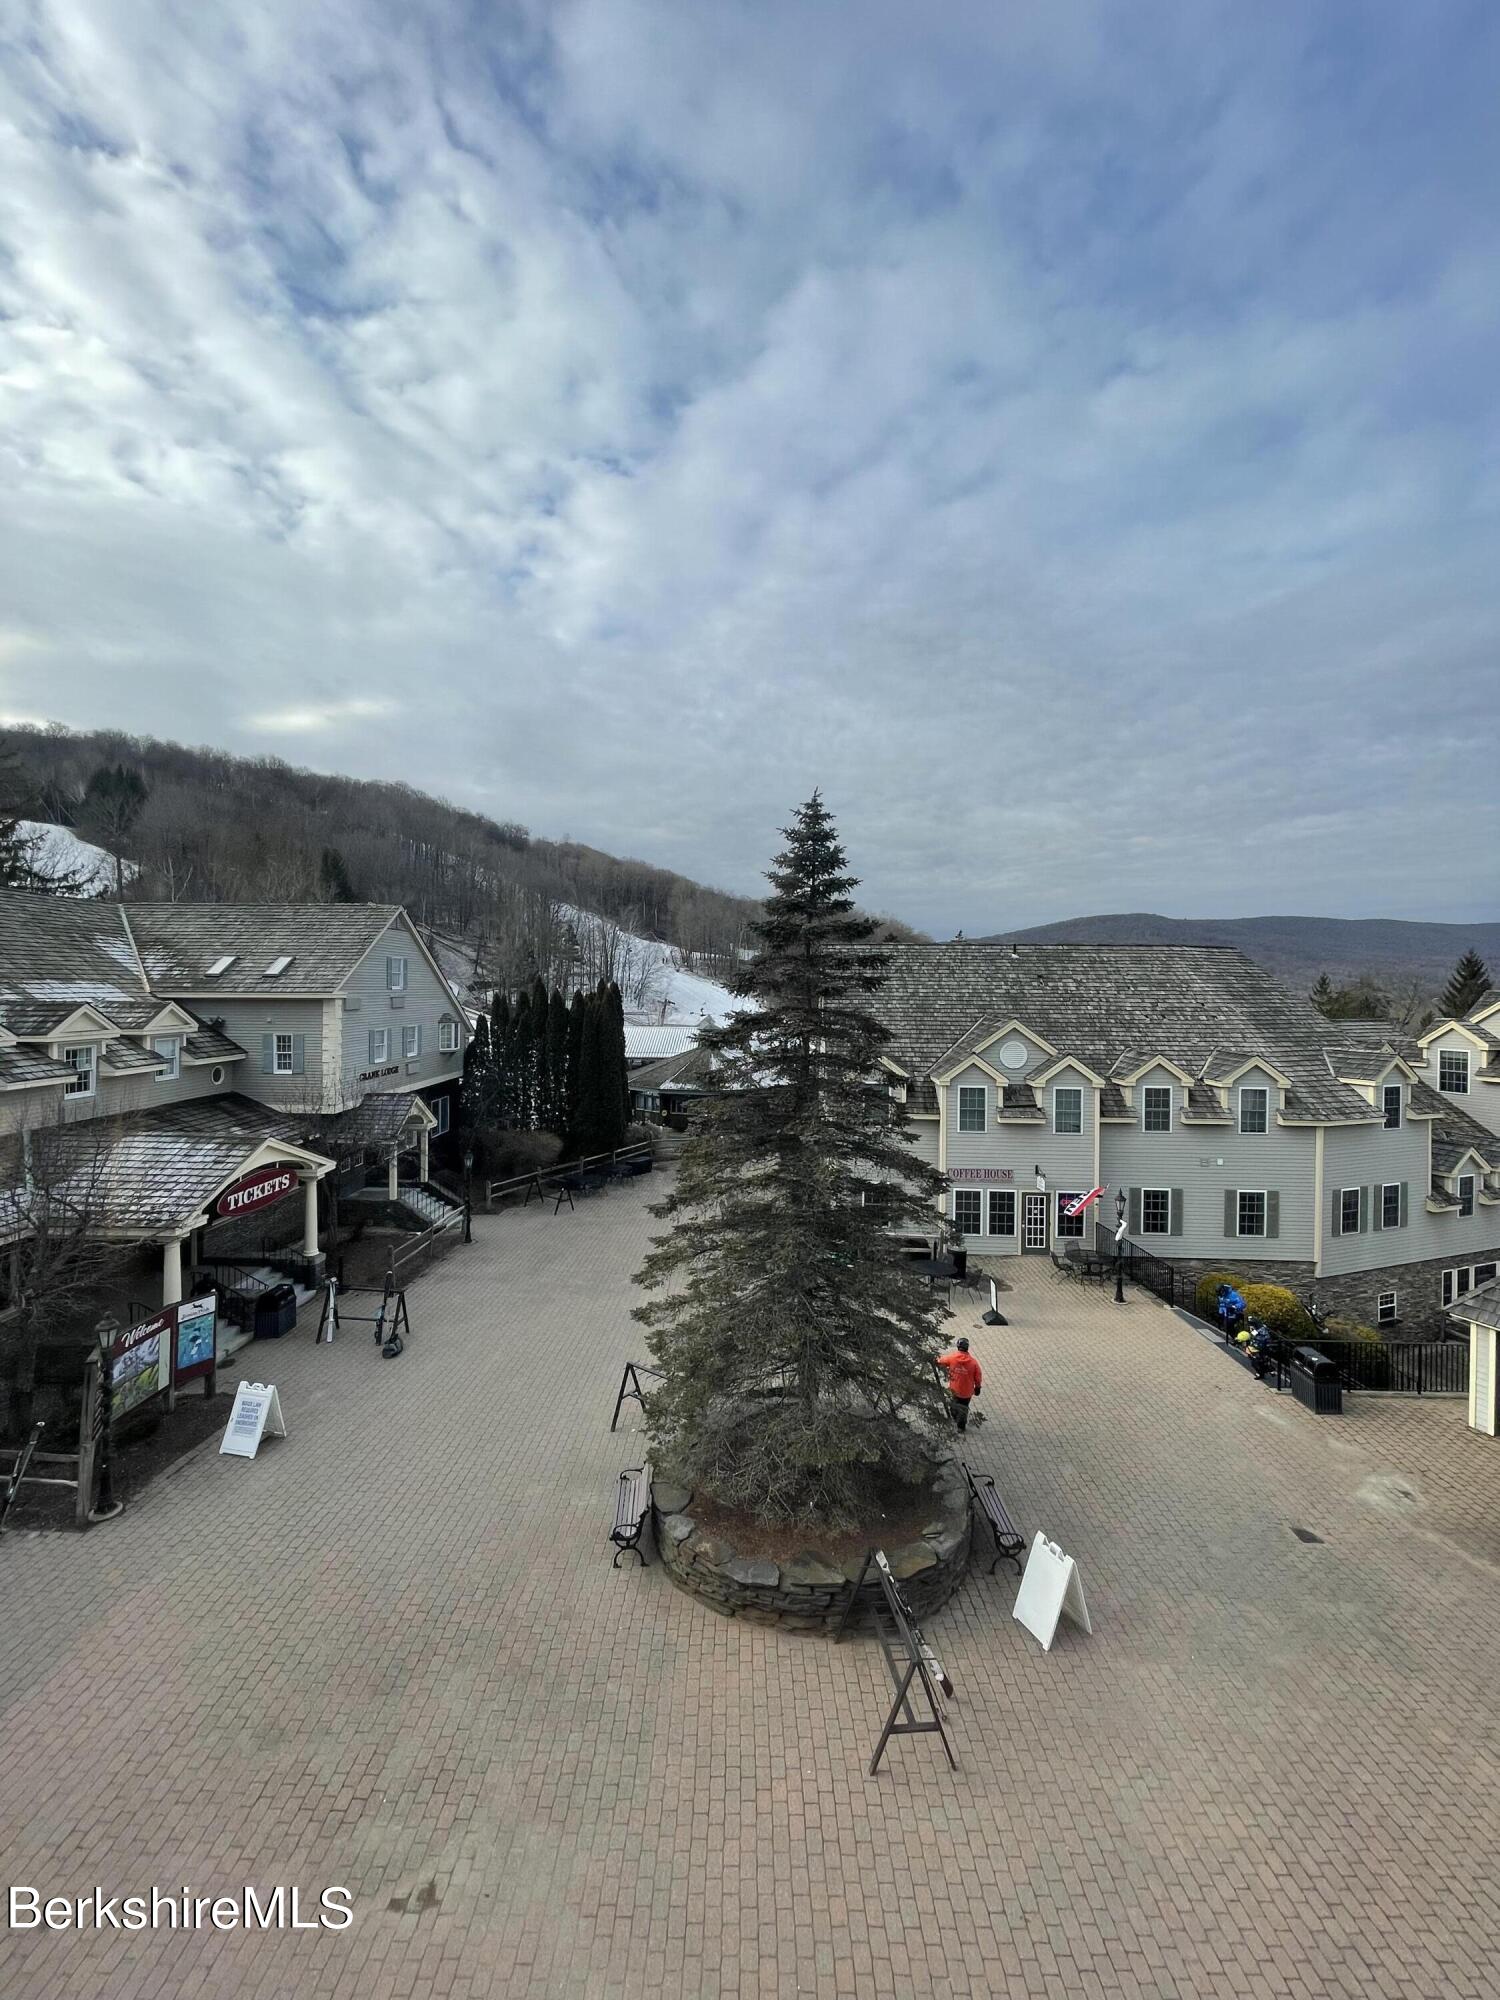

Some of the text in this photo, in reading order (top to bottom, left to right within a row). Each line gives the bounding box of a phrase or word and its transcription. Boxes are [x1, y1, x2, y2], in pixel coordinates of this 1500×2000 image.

[948, 1168, 1013, 1179] COFFEE HOUSE
[227, 1173, 290, 1211] TICKETS
[121, 1319, 164, 1348] Welcome
